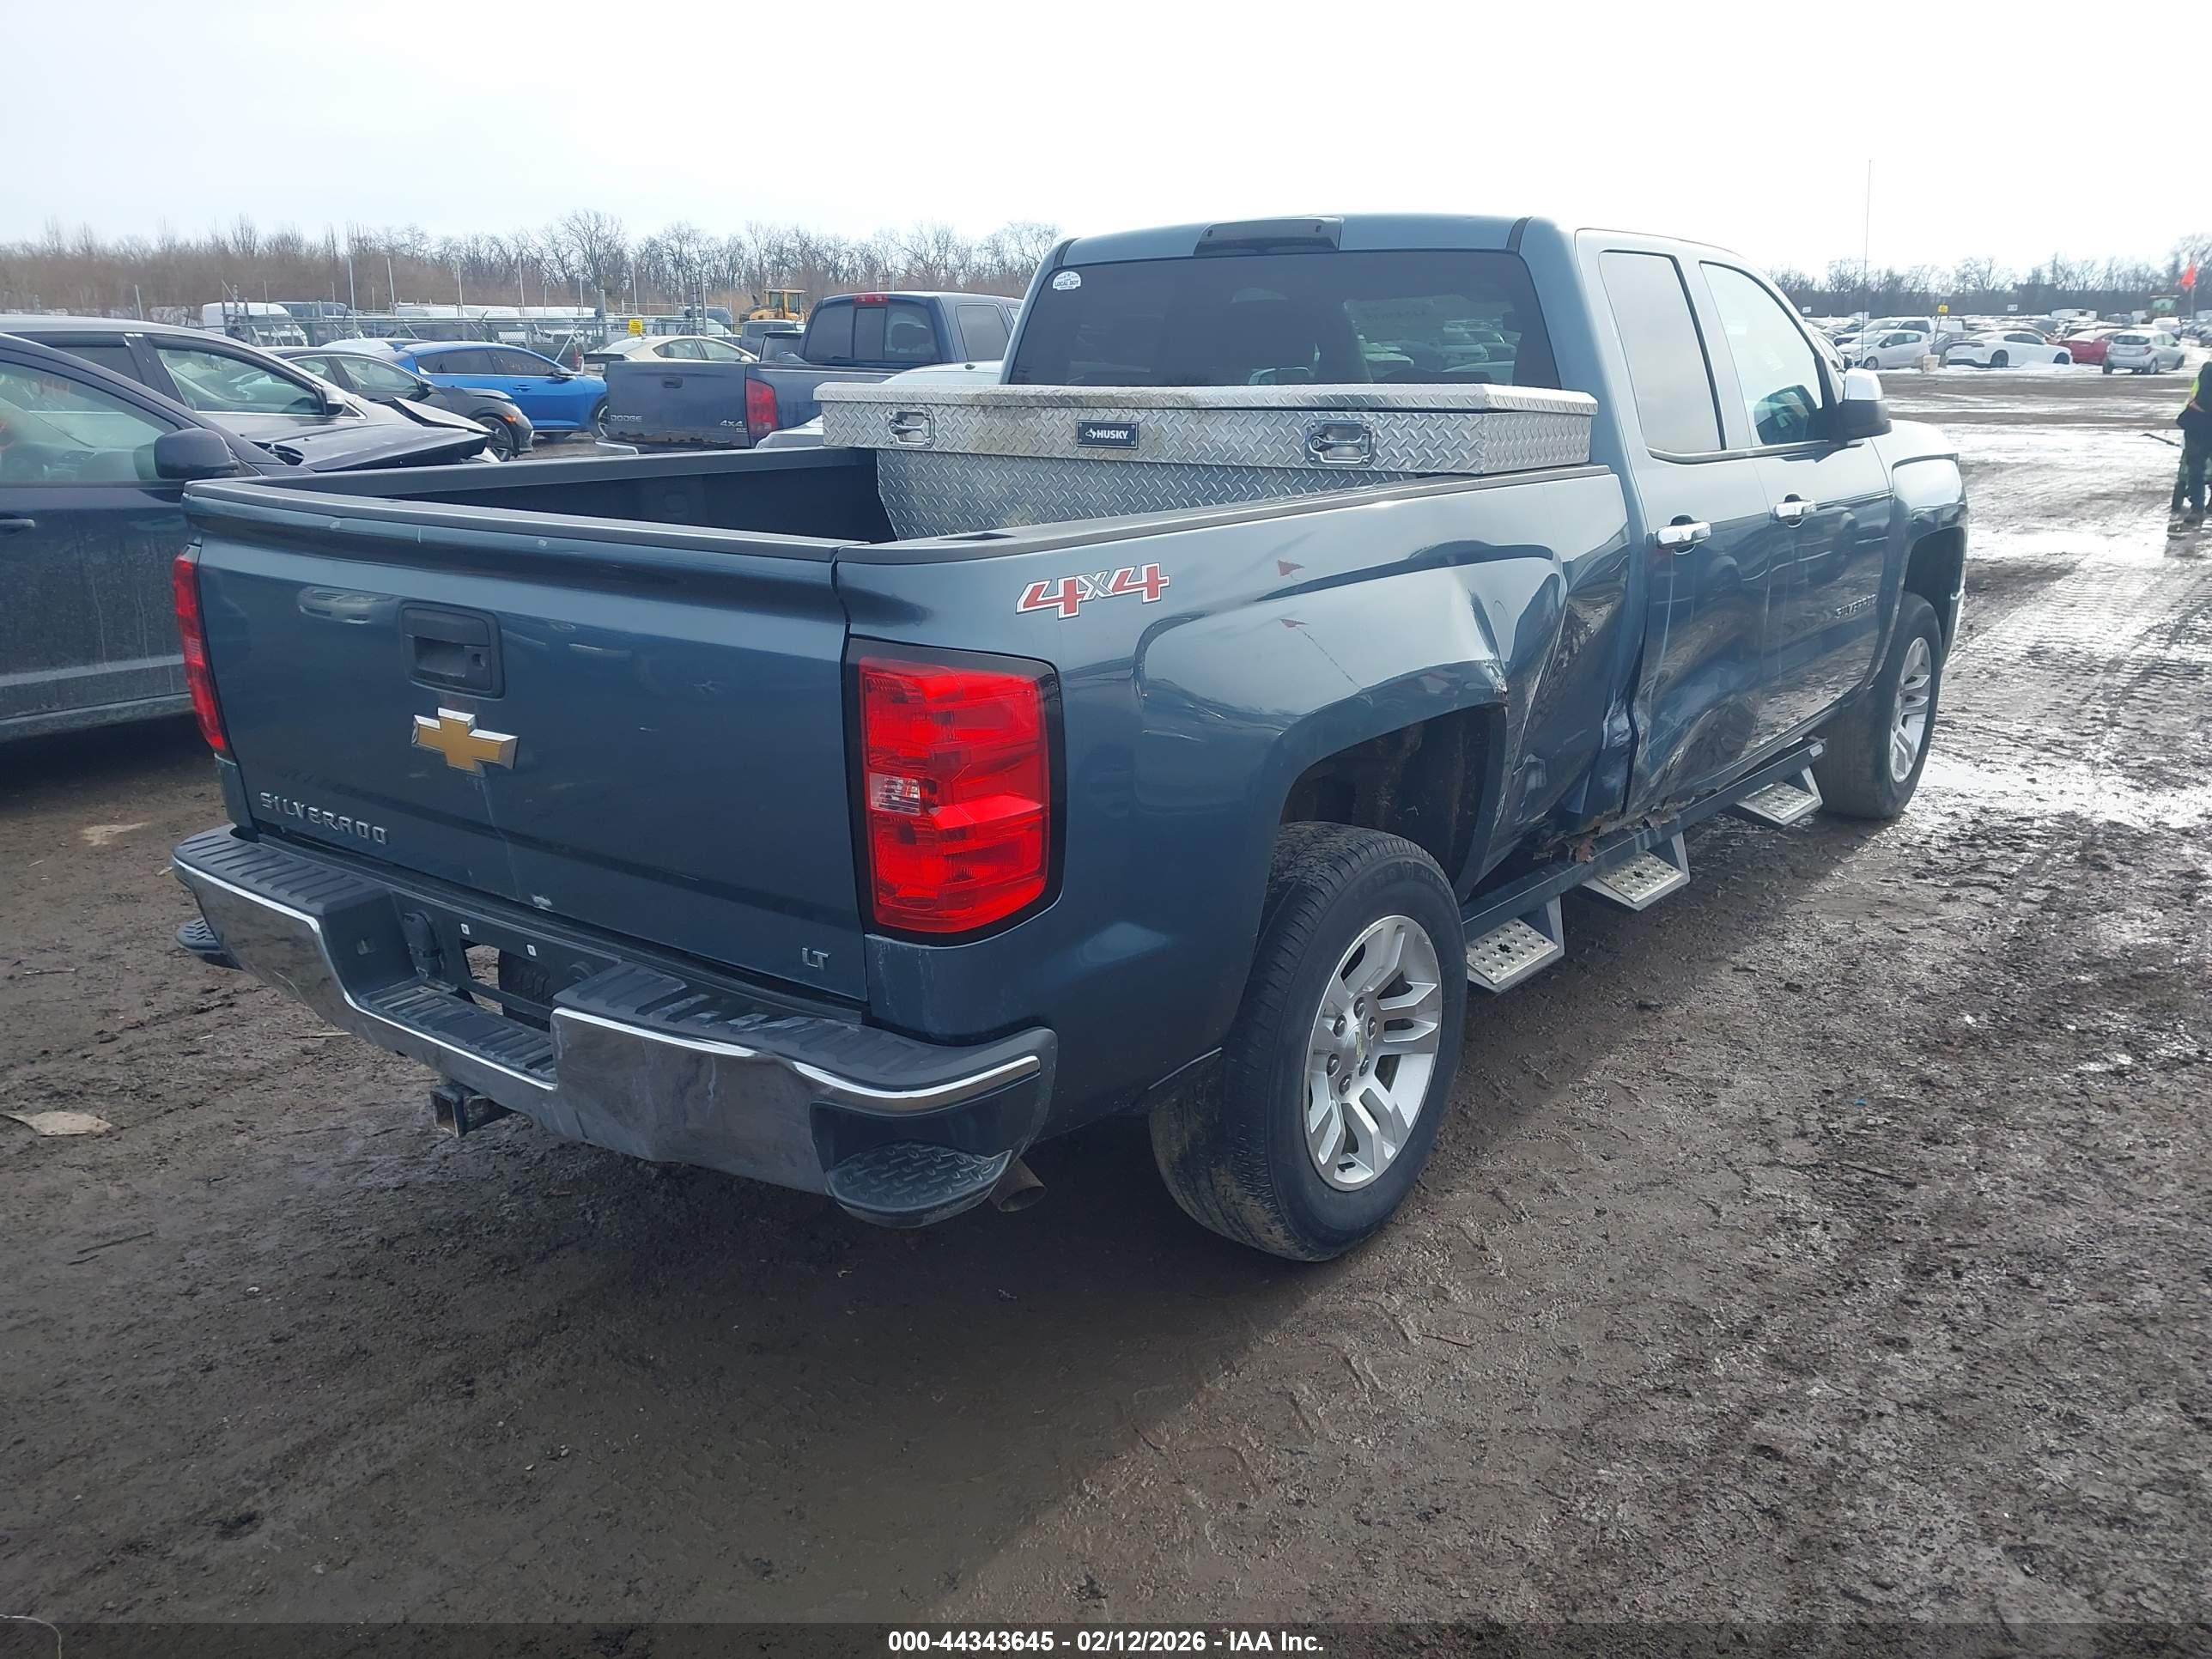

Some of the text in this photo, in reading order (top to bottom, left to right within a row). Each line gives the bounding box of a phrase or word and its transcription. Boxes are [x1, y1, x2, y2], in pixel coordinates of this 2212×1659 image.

[611, 414, 643, 422] DODGE
[1097, 429, 1129, 439] HUSKY
[260, 792, 387, 845] SILVERADO
[801, 947, 830, 969] LT
